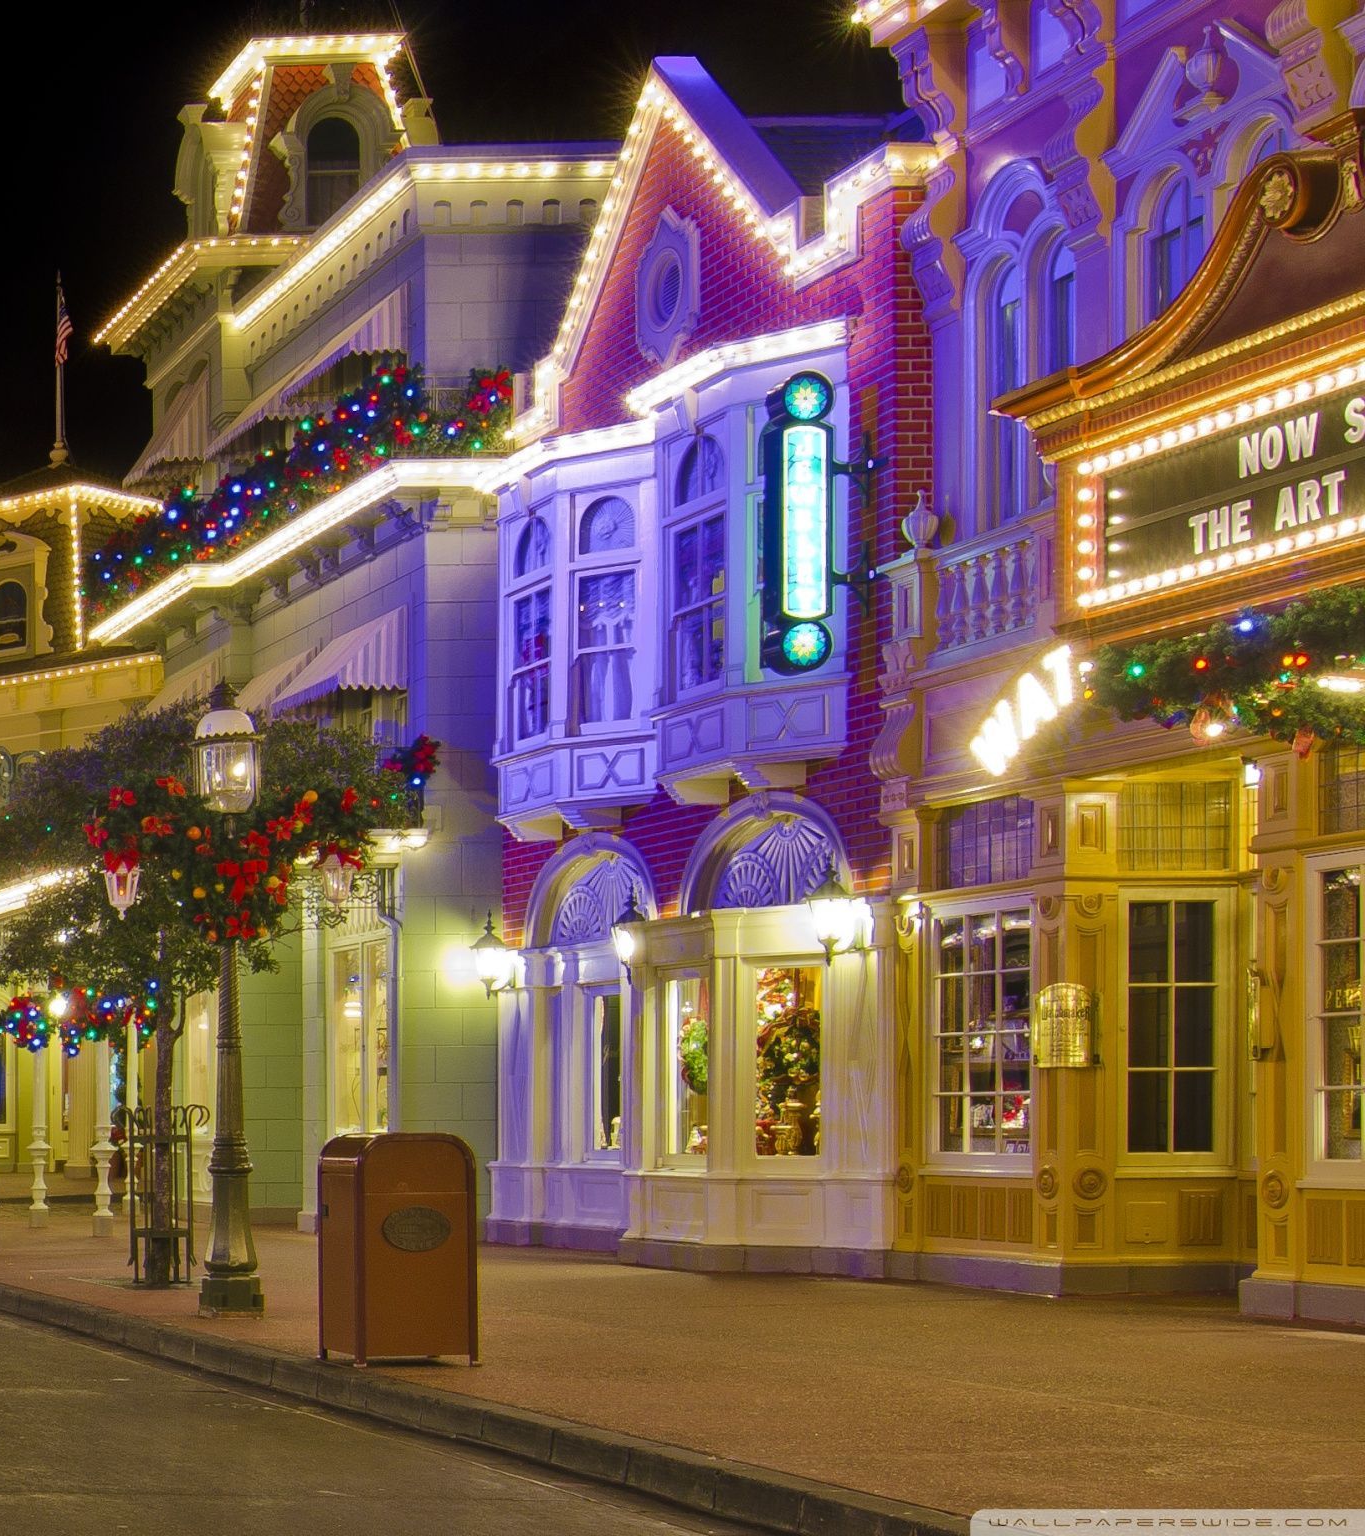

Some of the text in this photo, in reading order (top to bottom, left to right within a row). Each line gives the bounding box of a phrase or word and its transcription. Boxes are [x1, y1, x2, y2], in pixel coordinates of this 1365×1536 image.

[1238, 412, 1319, 479] NOW
[1188, 470, 1346, 555] THE ART
[969, 644, 1074, 776] WAT
